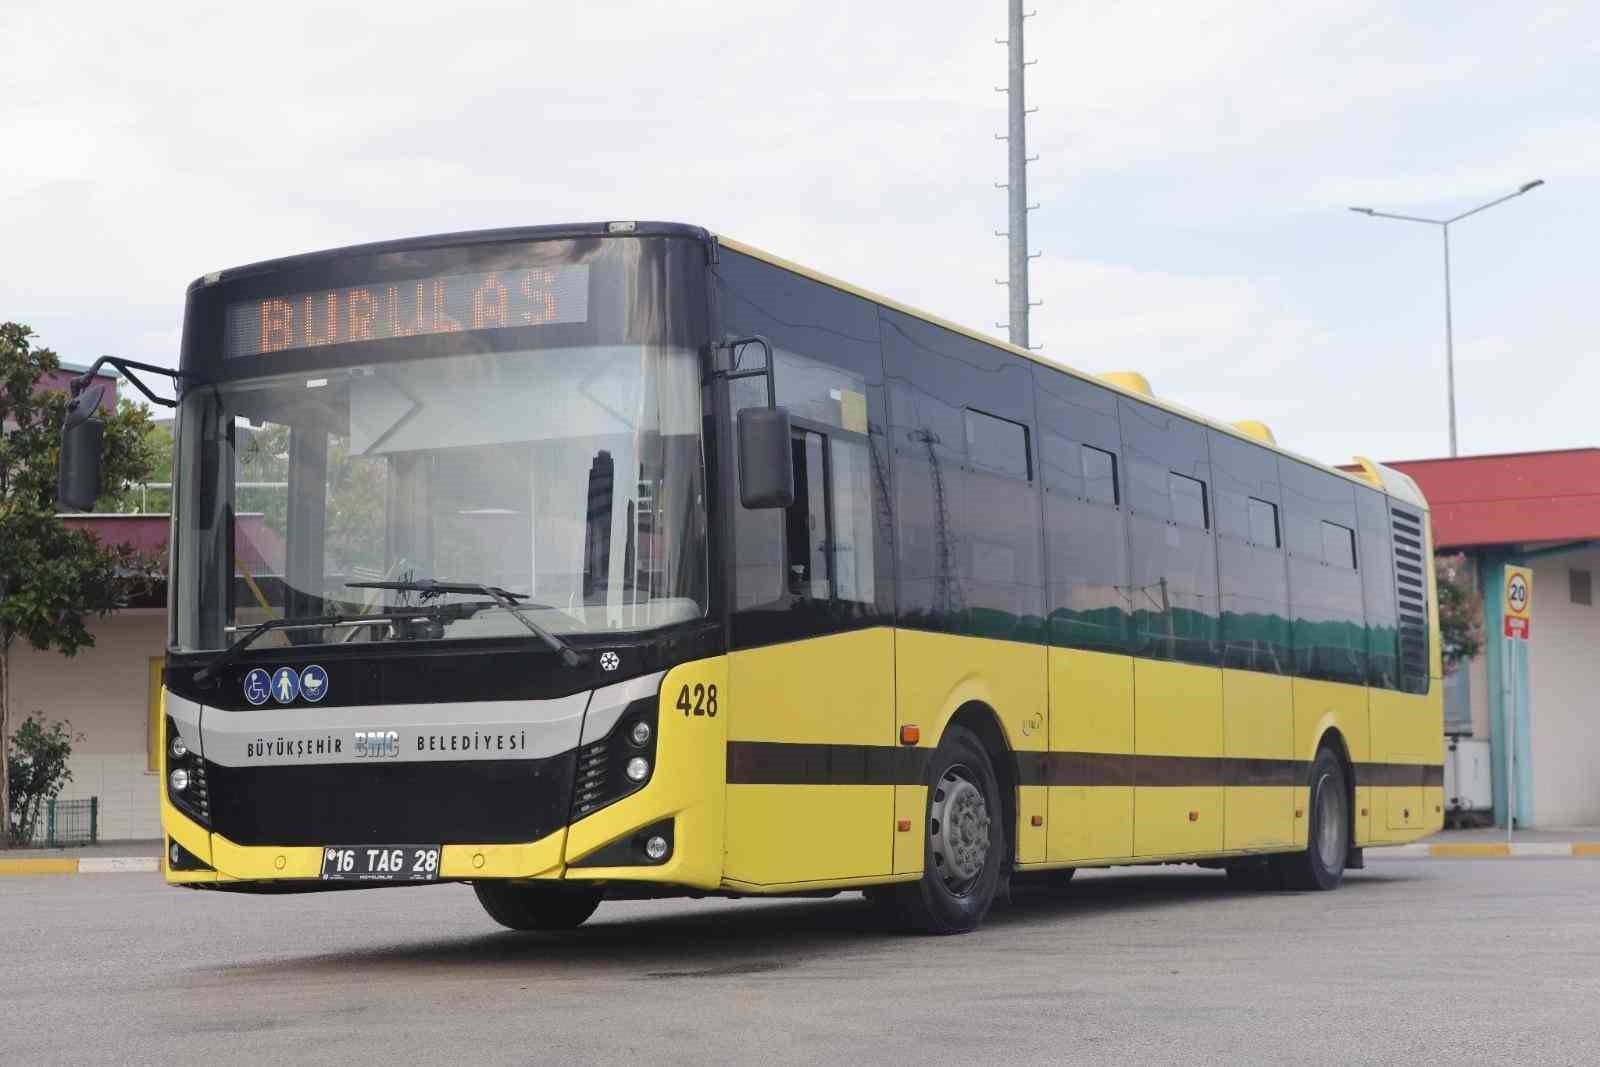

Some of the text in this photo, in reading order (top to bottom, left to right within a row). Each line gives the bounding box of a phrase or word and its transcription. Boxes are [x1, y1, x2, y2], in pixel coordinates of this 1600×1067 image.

[1511, 584, 1525, 602] 20
[676, 683, 718, 717] 428
[247, 735, 342, 758] BÜYÜKŞEHİR
[353, 731, 400, 758] BMC
[417, 730, 525, 751] BELEDİYESİ
[336, 849, 438, 872] 16 TAG 28
